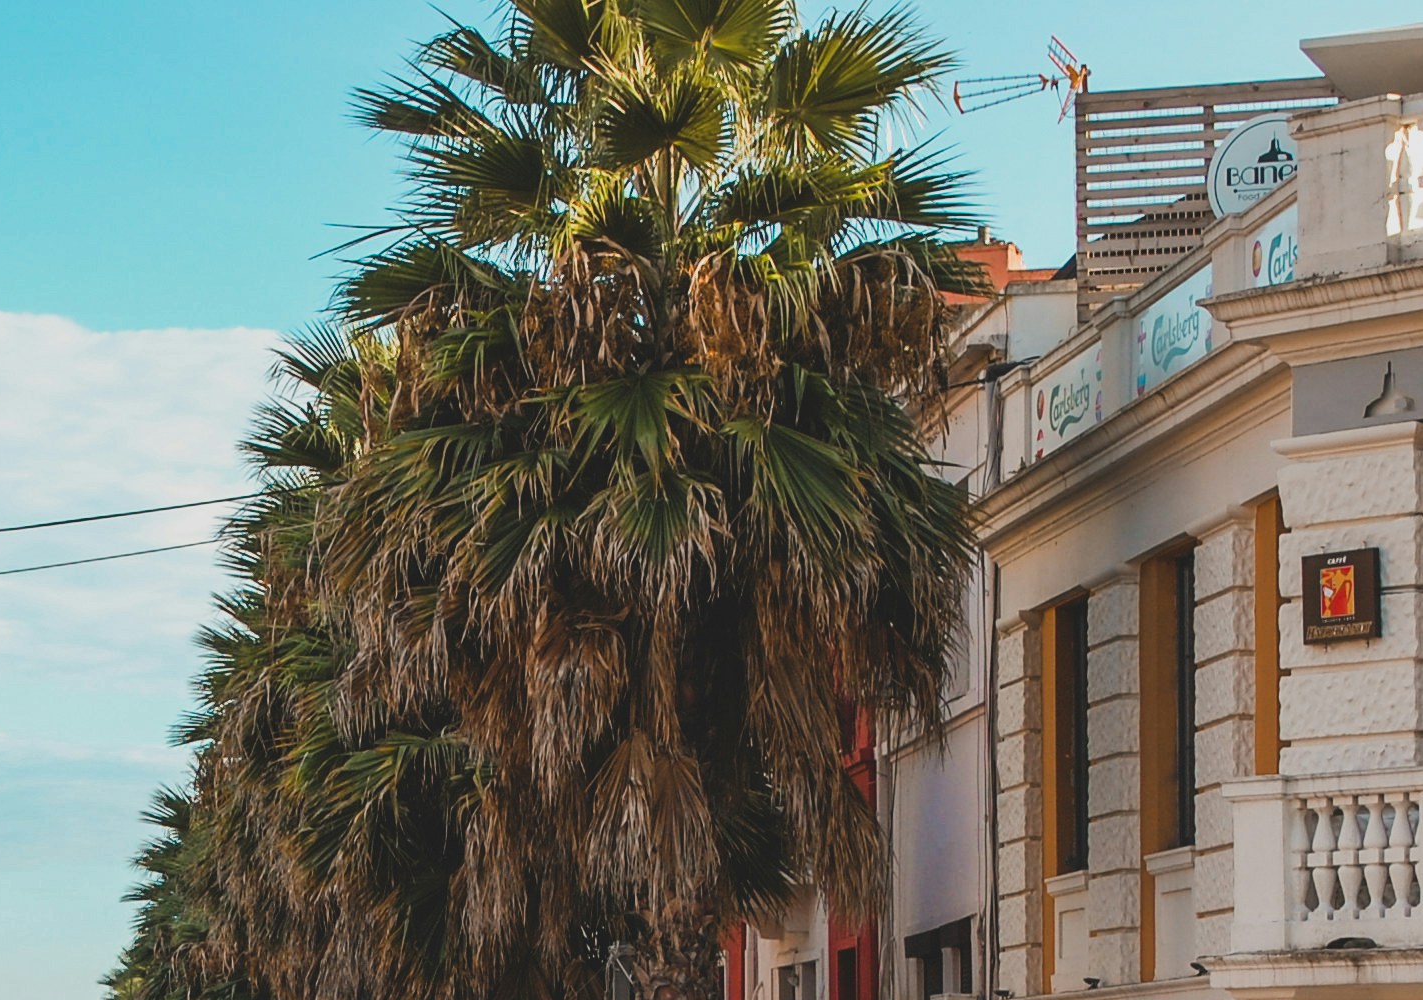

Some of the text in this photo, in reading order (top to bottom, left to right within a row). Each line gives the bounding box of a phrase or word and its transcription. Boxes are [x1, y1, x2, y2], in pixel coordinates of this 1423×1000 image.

[1226, 164, 1297, 187] Bane
[1268, 231, 1298, 286] Carls
[1151, 310, 1200, 371] Carlsberg
[1049, 382, 1090, 437] Carlsberg
